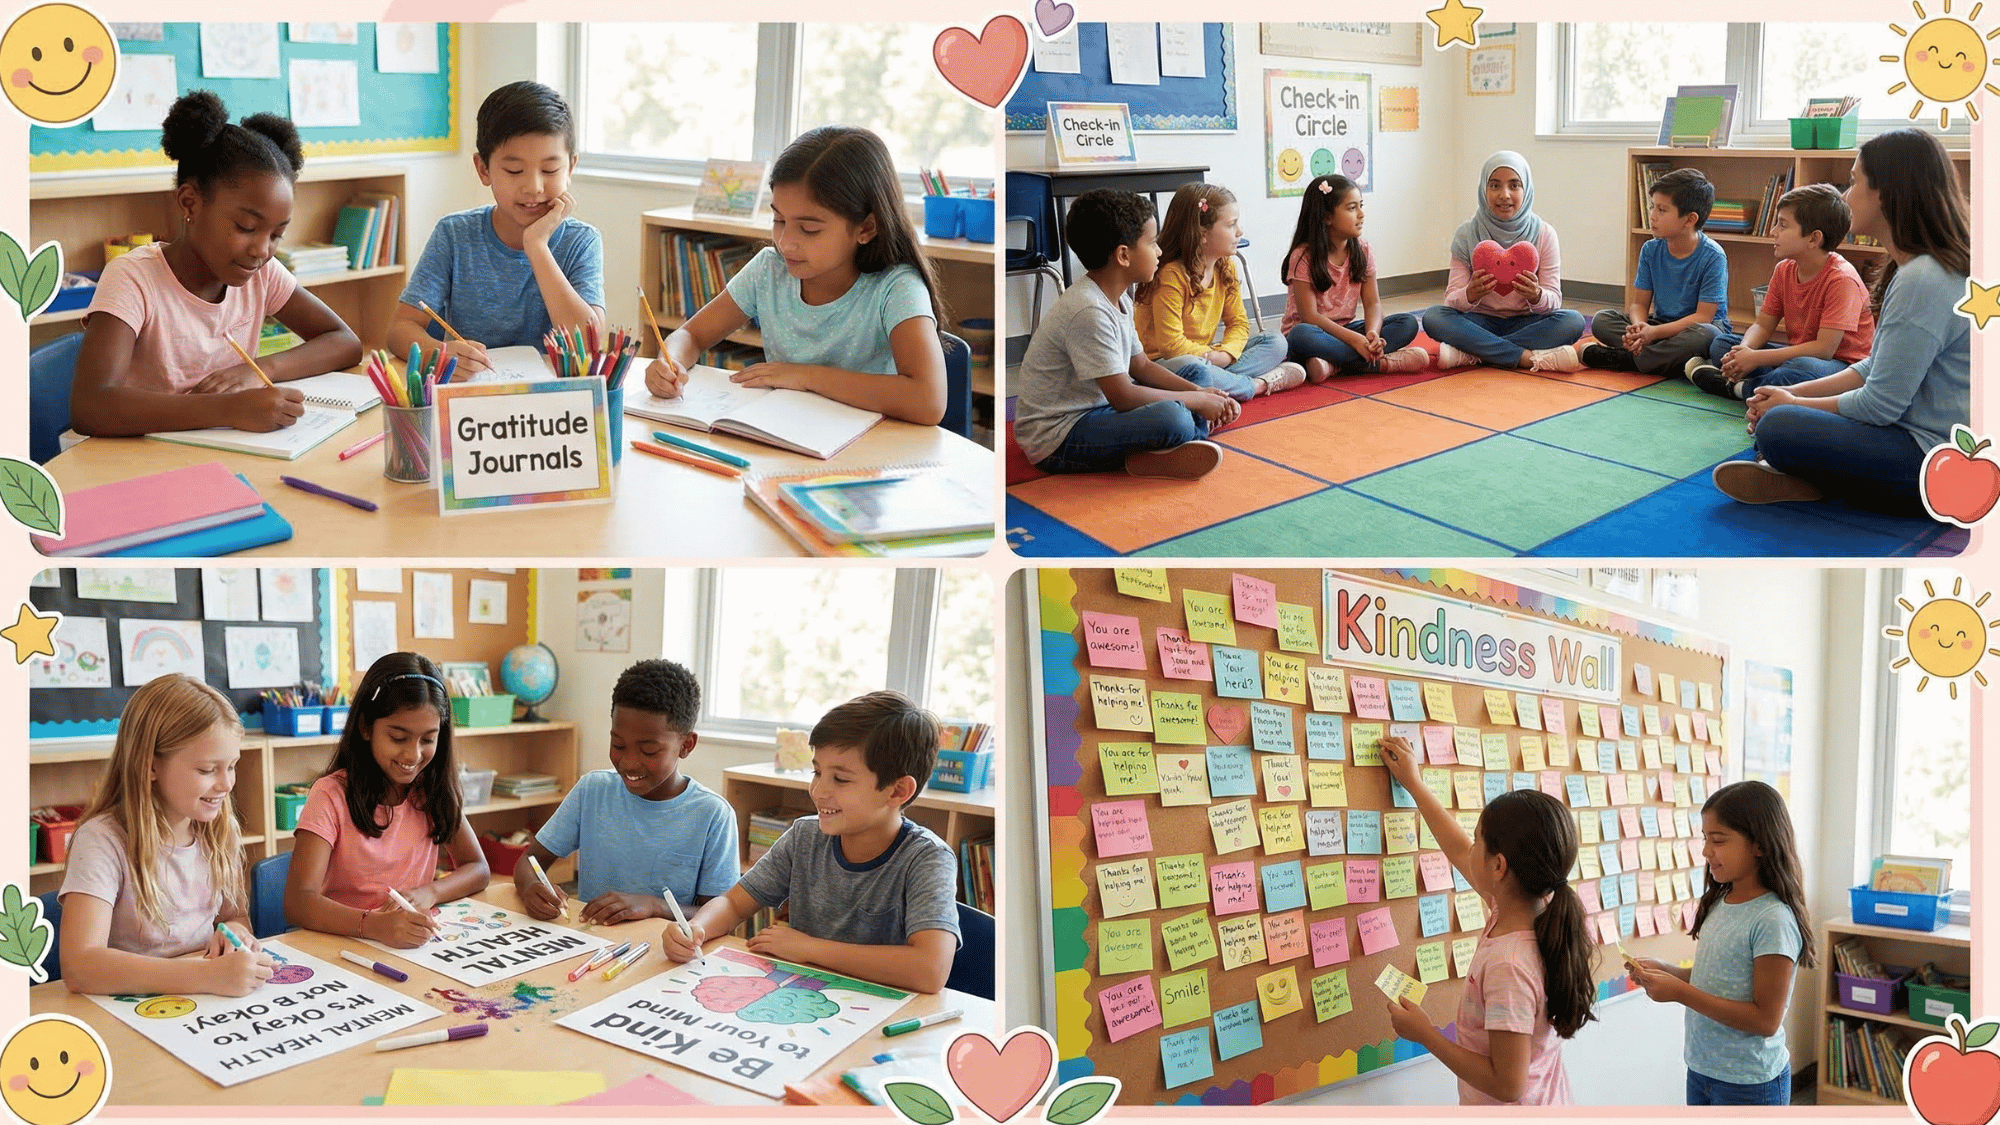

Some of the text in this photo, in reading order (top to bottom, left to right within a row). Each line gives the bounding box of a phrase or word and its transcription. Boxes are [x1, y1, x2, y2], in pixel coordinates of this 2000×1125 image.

[1280, 85, 1360, 110] Check-in
[1063, 117, 1120, 131] Check-in
[1295, 114, 1347, 137] Circle
[1076, 133, 1114, 146] Circle
[457, 411, 588, 442] Gratitude
[468, 445, 583, 475] Journals
[1187, 600, 1204, 613] You
[1088, 621, 1130, 635] You are
[1337, 588, 1615, 692] Kindness Wall
[1091, 641, 1139, 654] awesome!
[1266, 656, 1282, 669] You
[1268, 671, 1300, 688] helping
[1093, 681, 1141, 694] Thanks for
[1097, 695, 1129, 709] helping
[1155, 699, 1184, 710] Thanks
[1102, 747, 1119, 758] You
[1114, 761, 1147, 773] helping
[1120, 774, 1138, 785] me!
[1100, 867, 1129, 877] Thanks
[1214, 871, 1246, 881] Thanks
[1104, 879, 1132, 891] helping
[1215, 883, 1227, 892] for
[1103, 927, 1142, 940] You are
[431, 926, 552, 962] HEALTH
[1104, 943, 1143, 953] awesome
[461, 935, 586, 974] MENTAL
[1105, 983, 1144, 1004] You are
[1165, 976, 1206, 1005] Smile!
[182, 980, 349, 1035] Not B Okay!
[213, 994, 374, 1046] It's Okay to
[627, 999, 811, 1060] to Your Mind
[219, 1004, 415, 1070] MENTAL HEALTH
[590, 1012, 774, 1080] Be Kind
